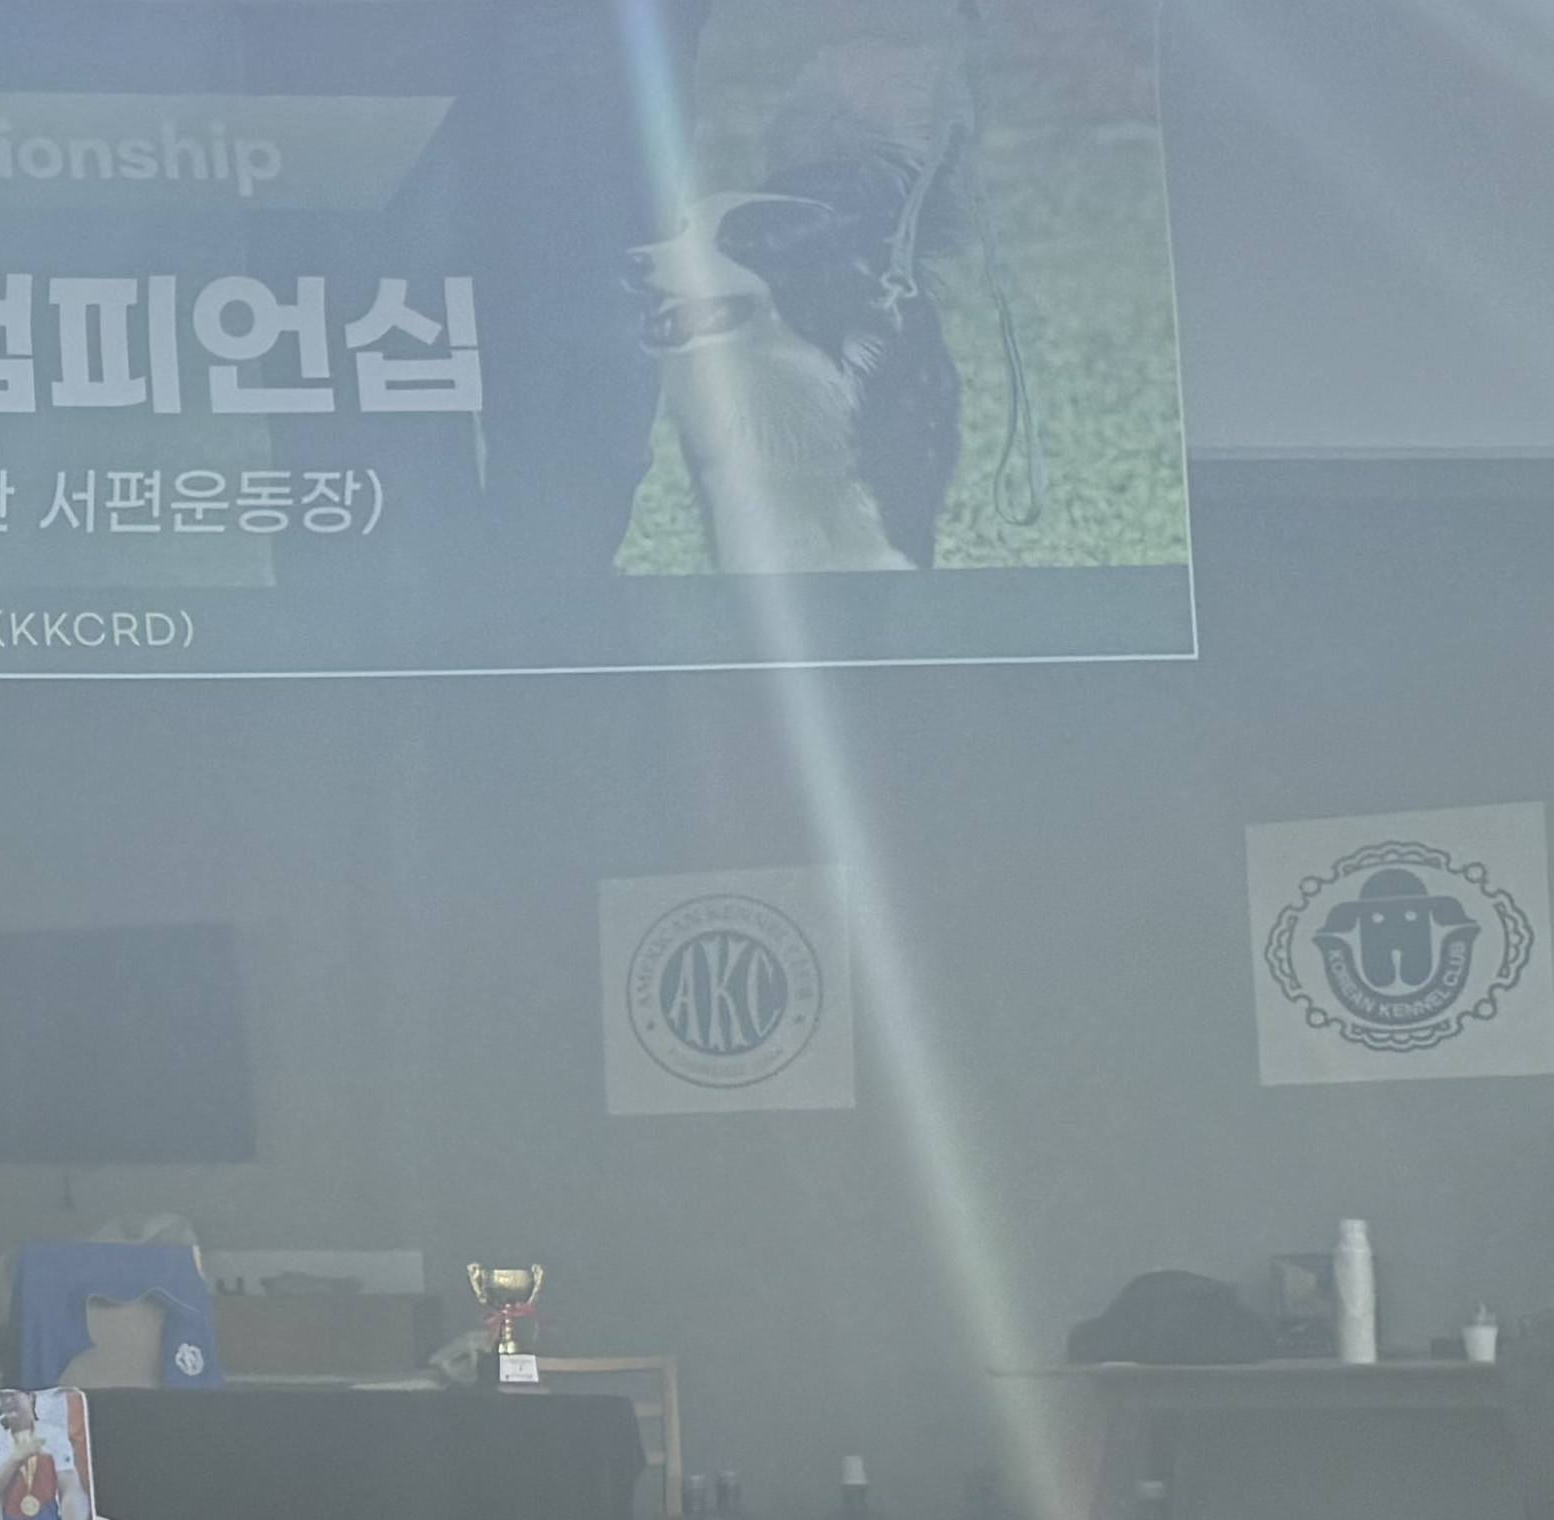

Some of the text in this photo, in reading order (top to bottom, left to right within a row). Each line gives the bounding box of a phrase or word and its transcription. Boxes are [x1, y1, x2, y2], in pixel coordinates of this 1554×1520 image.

[38, 467, 385, 538] 서편운동장)
[667, 935, 780, 1052] AKC
[1327, 940, 1466, 1018] KOREAN KENNEL CLUB
